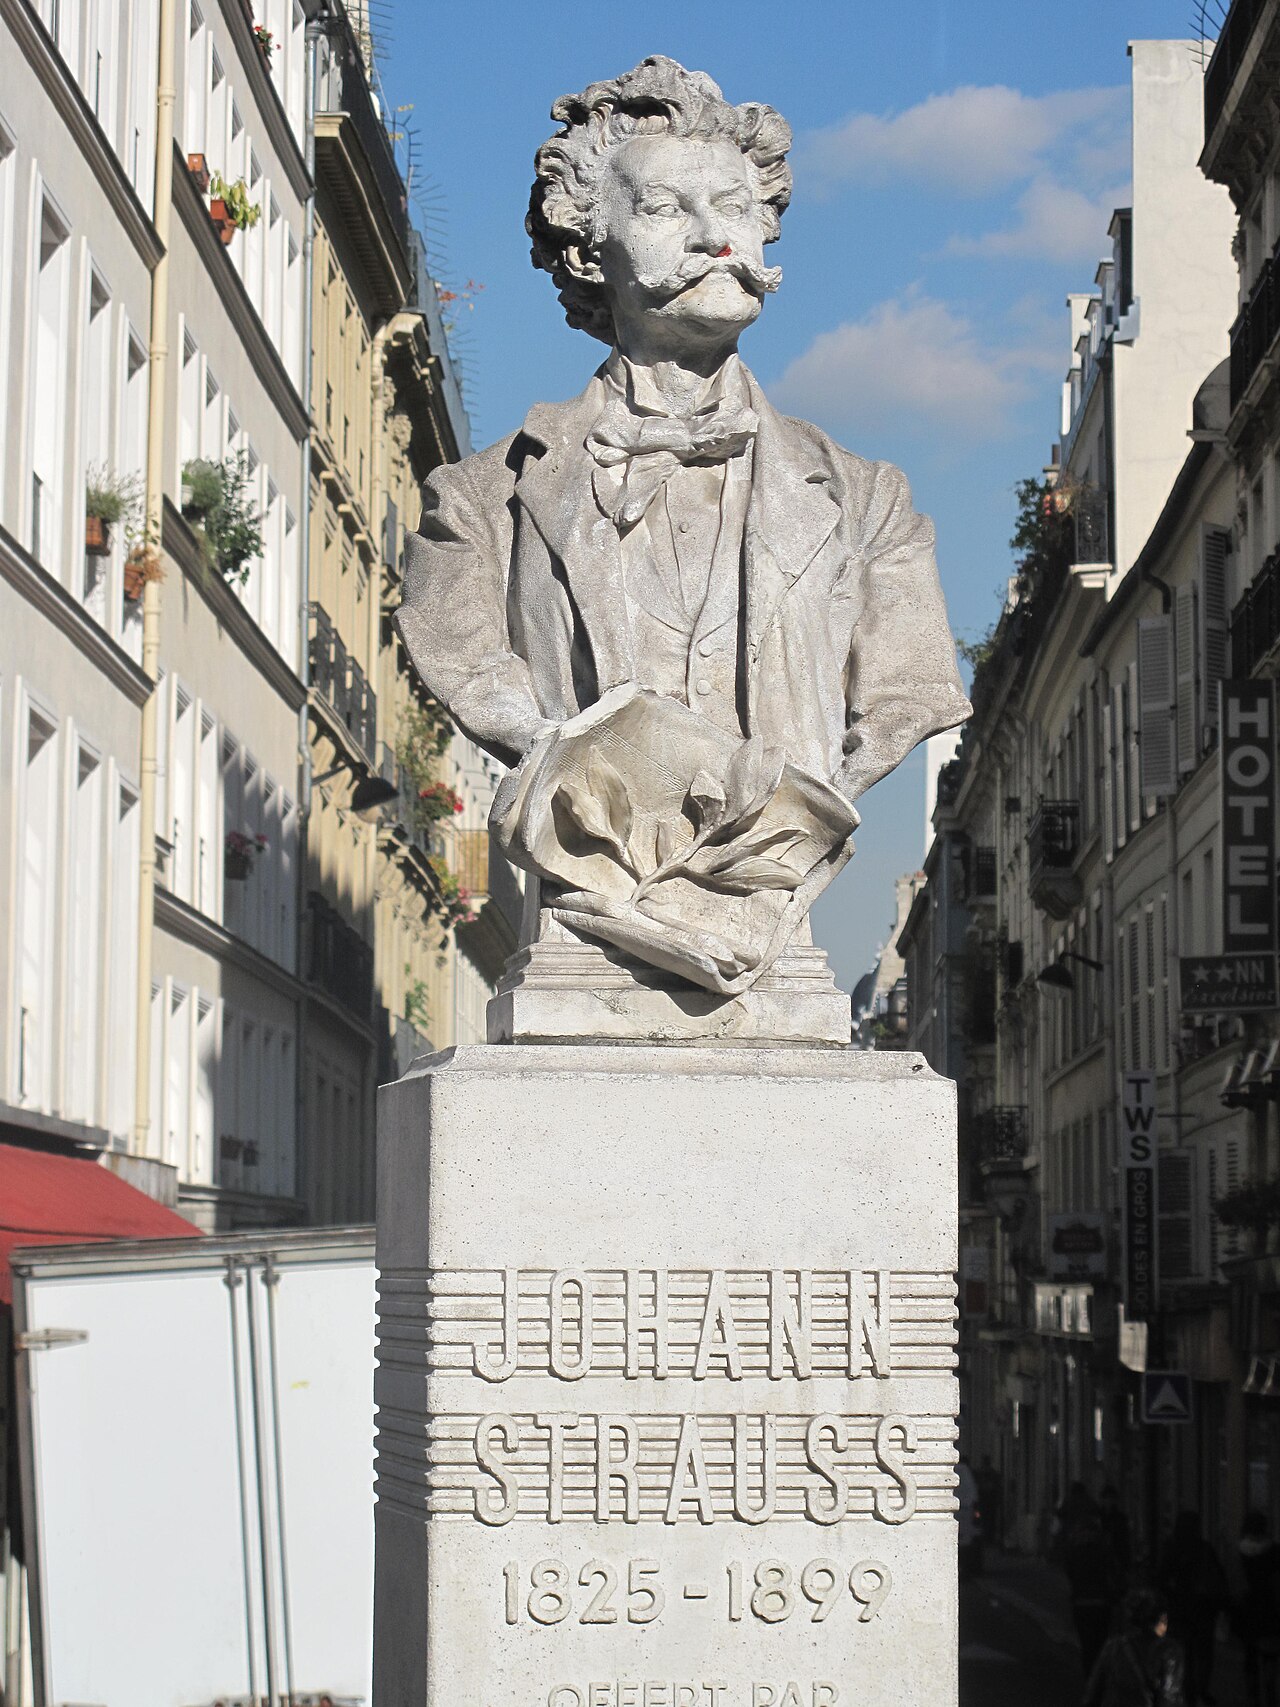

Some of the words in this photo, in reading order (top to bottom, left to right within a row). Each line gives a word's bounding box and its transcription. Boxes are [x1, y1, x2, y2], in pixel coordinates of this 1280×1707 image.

[1227, 697, 1270, 935] HOTEL
[1124, 1078, 1155, 1161] TWS
[1133, 1170, 1148, 1218] GROS
[1134, 1223, 1148, 1245] EN
[472, 1268, 892, 1382] JOHANN
[473, 1412, 918, 1526] STRAUSS
